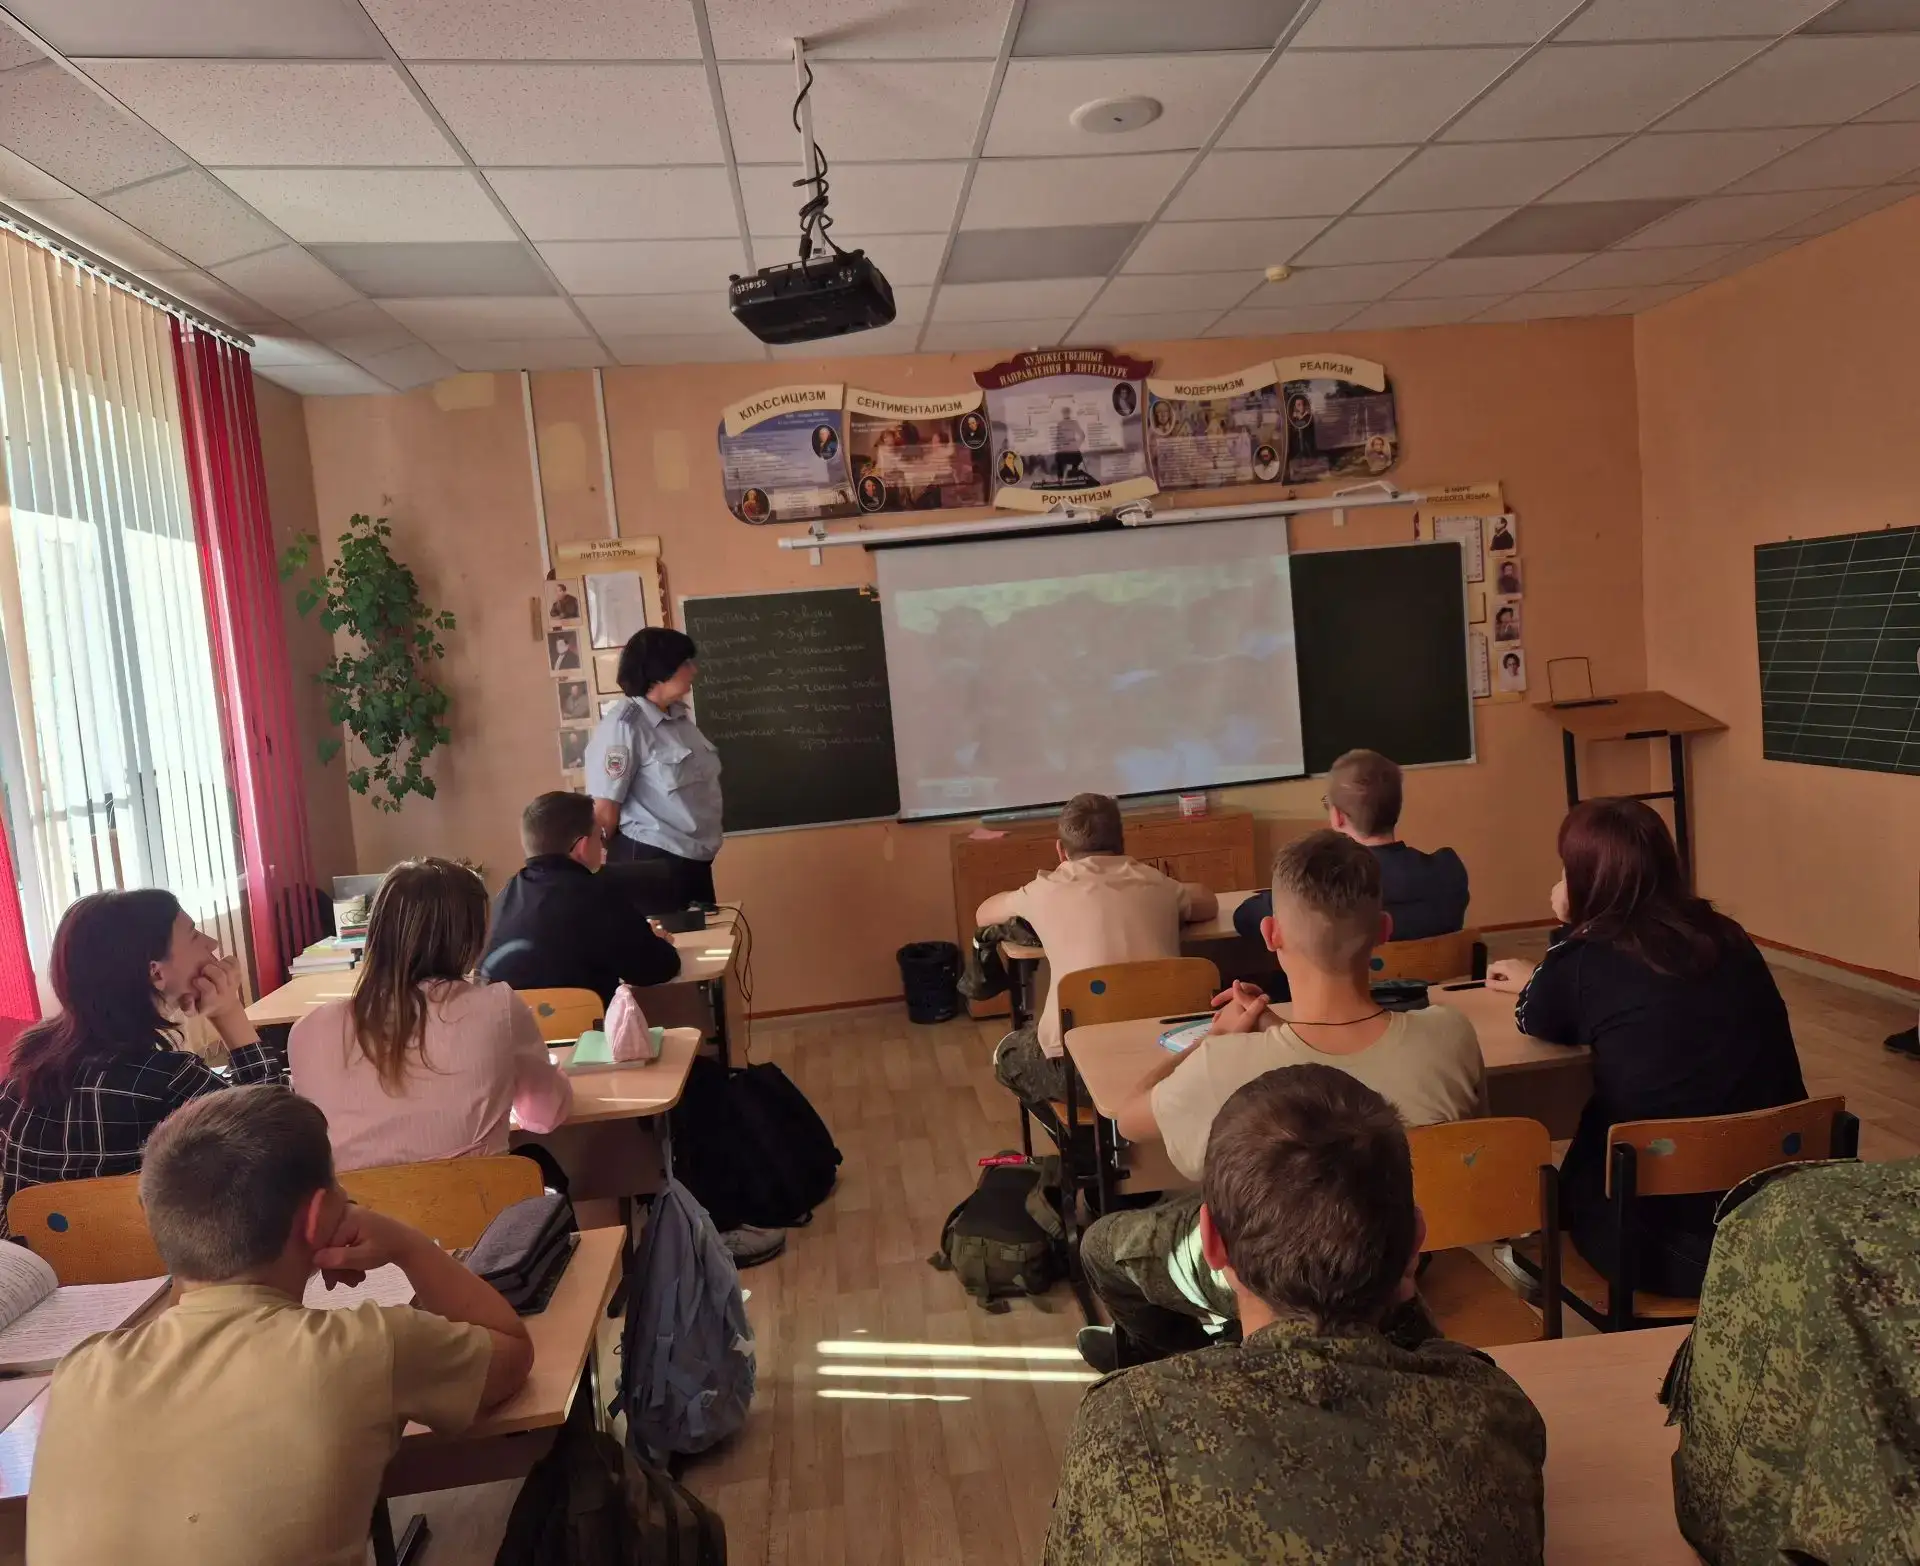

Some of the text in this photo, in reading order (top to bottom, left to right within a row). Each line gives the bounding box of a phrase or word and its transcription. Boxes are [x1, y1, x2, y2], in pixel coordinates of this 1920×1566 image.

[1023, 351, 1104, 366] ХУДОЖЕСТВЕННЫЕ
[999, 363, 1128, 386] НАПРАВЛЕНИЯ В ЛИТЕРАТУРЕ
[1299, 360, 1353, 375] РЕАЛИЗМ
[1174, 378, 1245, 396] МОДЕРНИЗМ
[739, 390, 827, 421] КЛАССИЦИЗМ
[856, 396, 963, 415] СЕНТИМЕНТАЛИЗМ
[591, 540, 623, 550] В МИРЕ
[580, 549, 636, 560] ЛИТЕРАТУРЫ
